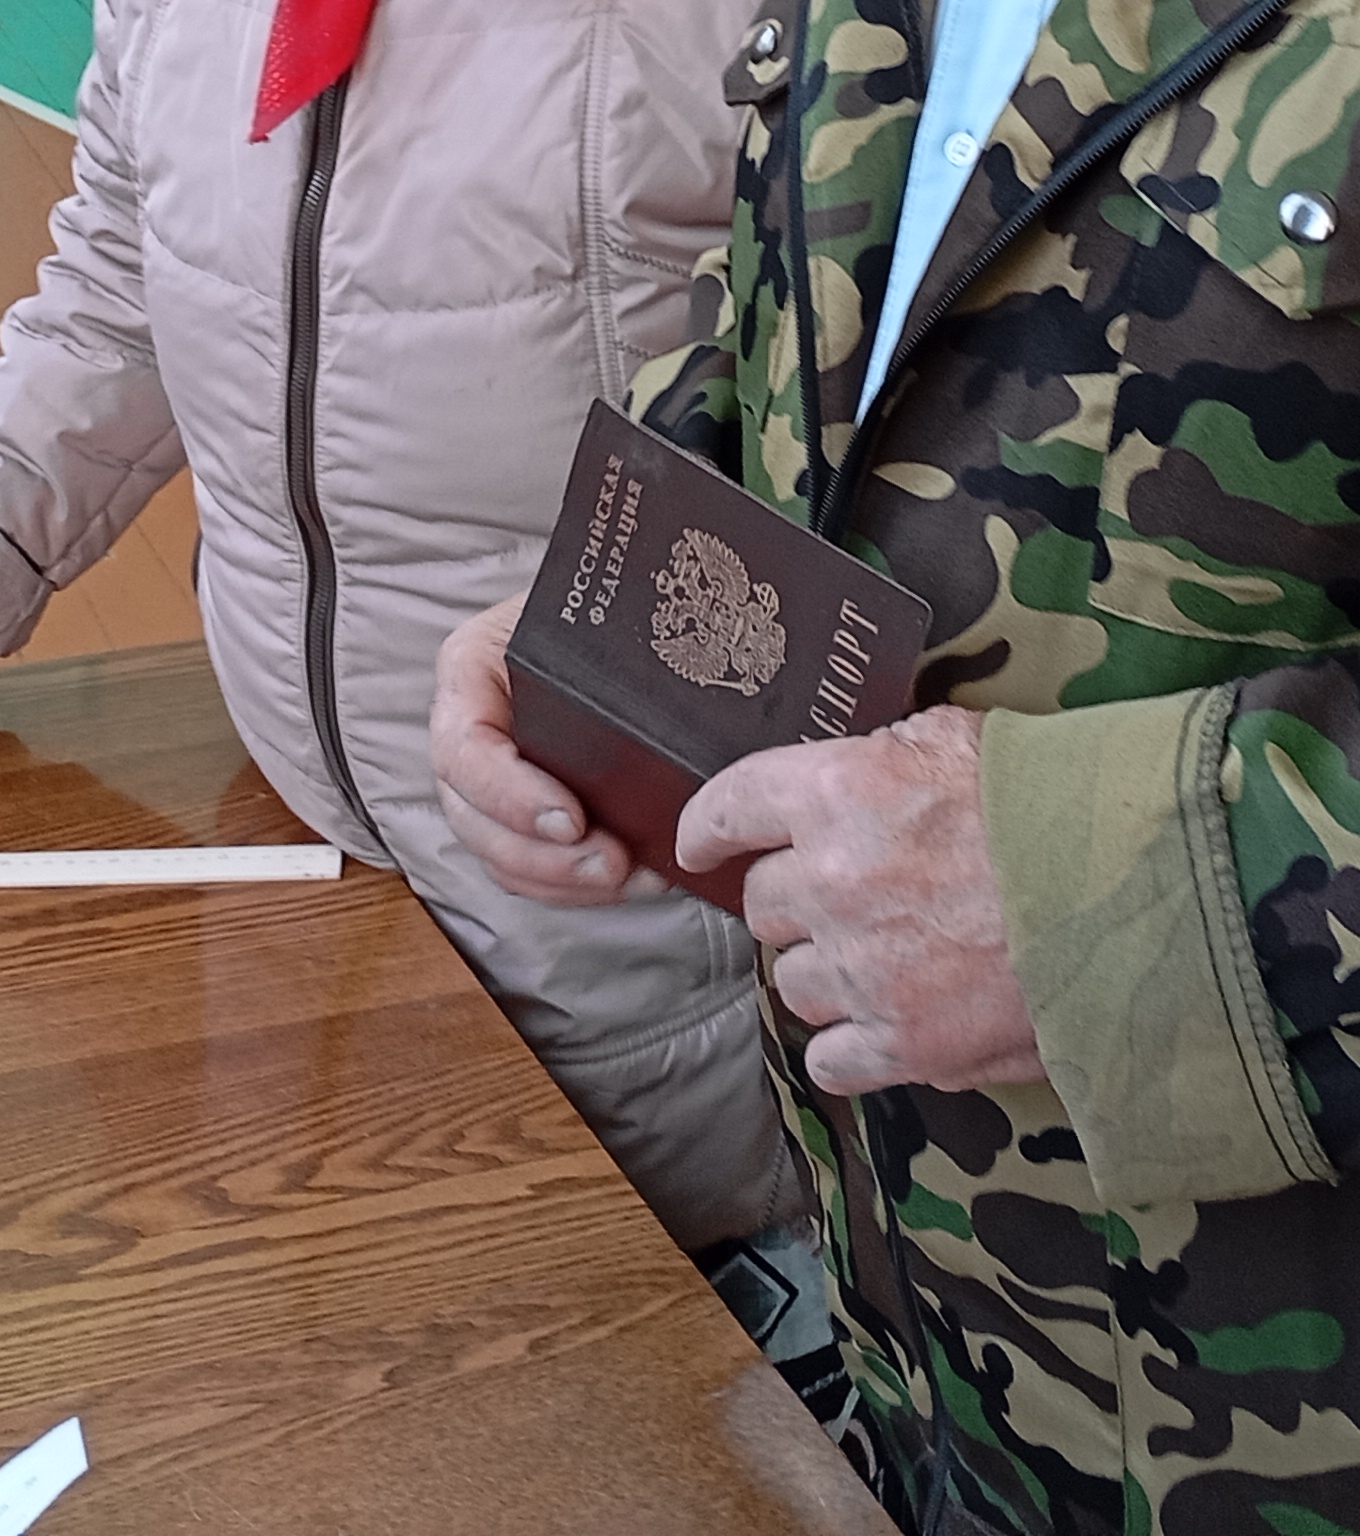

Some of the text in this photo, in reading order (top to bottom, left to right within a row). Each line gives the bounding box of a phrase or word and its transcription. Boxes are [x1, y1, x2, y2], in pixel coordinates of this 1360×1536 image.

[560, 453, 624, 625] РОССИЙСКАЯ
[589, 478, 643, 626] ФЕДЕРАЦИЯ
[800, 598, 879, 743] СПОРТ
